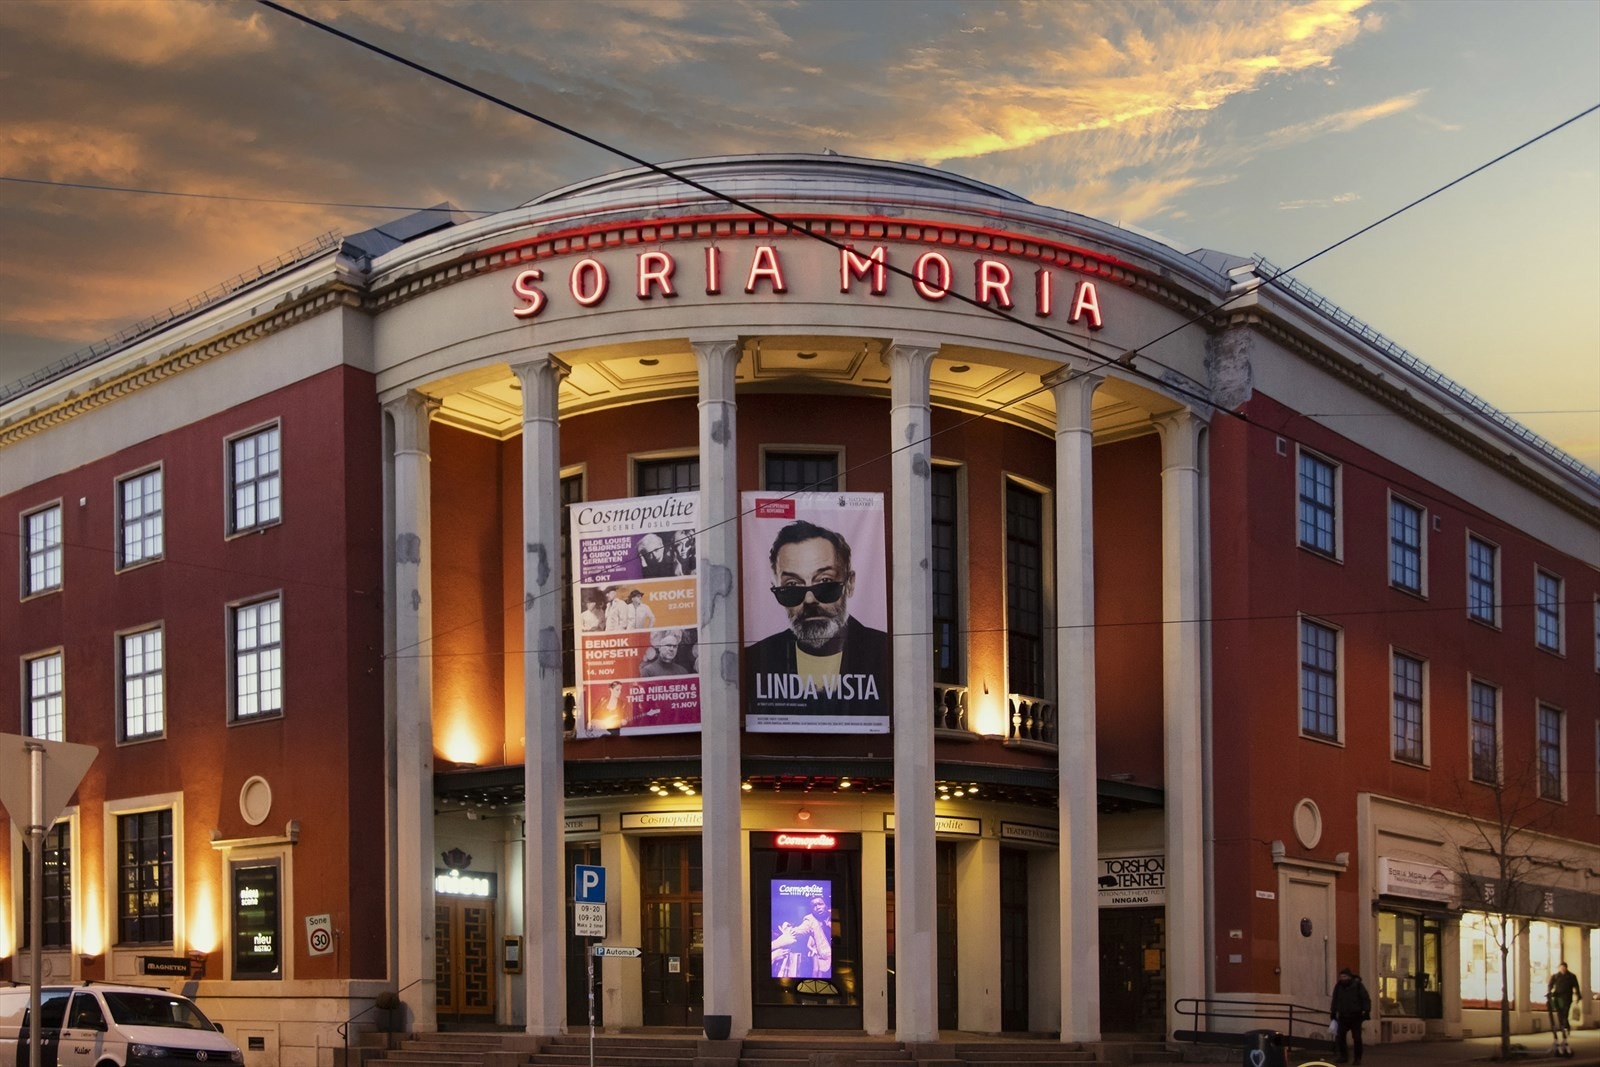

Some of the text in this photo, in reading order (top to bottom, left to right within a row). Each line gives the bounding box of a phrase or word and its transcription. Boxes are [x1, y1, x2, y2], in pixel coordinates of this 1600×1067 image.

[512, 245, 1103, 330] SORIA MORIA
[578, 497, 694, 529] Cosmopolite
[648, 520, 671, 528] OSLO
[582, 537, 631, 547] HILDE LOUISE
[582, 543, 631, 553] ASBJØRNSEN
[582, 556, 622, 565] GERMETEN
[649, 589, 694, 601] KROKE
[585, 638, 629, 649] BENDIK
[585, 648, 638, 659] HOFSETH
[629, 687, 645, 695] IDA
[648, 685, 688, 694] NIELSEN
[756, 672, 879, 700] LINDA VISTA
[626, 691, 697, 703] THE FUNKBOTS
[777, 834, 835, 849] Cosmopolite
[582, 870, 599, 898] P
[1116, 872, 1165, 887] TEATRET
[1112, 896, 1149, 904] INNGANG
[309, 917, 327, 925] Sone
[254, 932, 272, 944] nieu
[314, 934, 327, 946] 30
[147, 963, 187, 971] MAGNETEN
